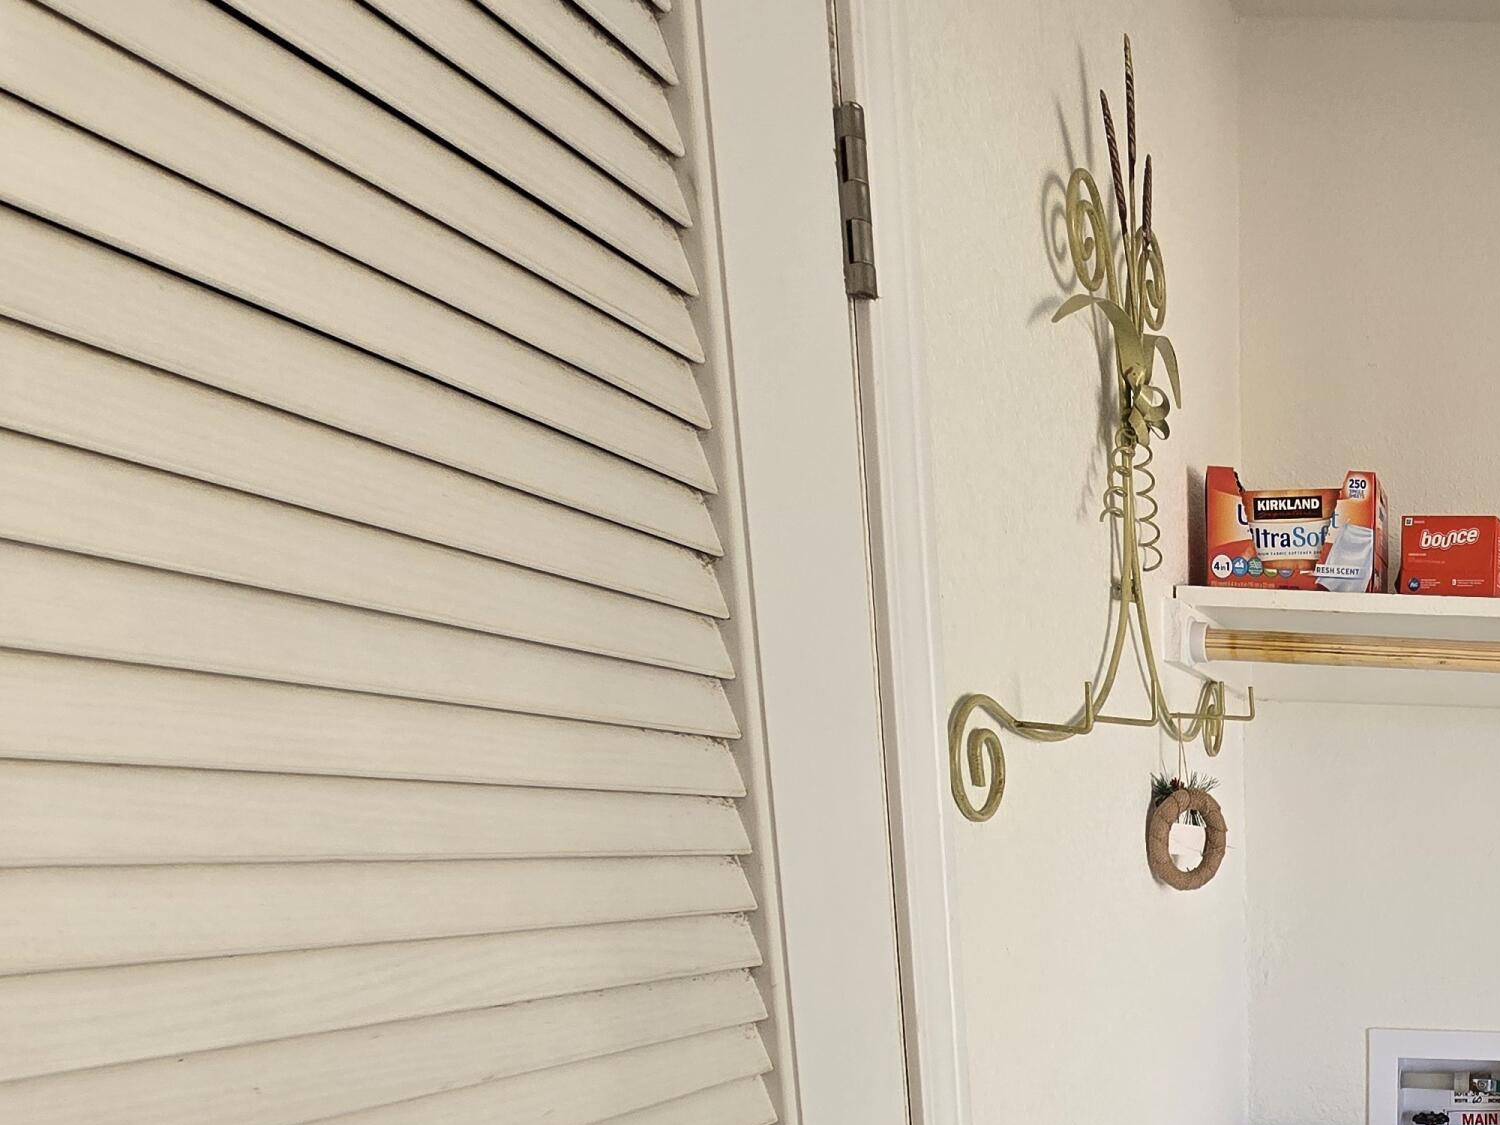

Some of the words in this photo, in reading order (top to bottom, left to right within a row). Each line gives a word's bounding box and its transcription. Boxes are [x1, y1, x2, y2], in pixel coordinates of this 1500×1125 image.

[1348, 478, 1367, 490] 250
[1257, 498, 1320, 511] KIRKLAND
[1249, 525, 1329, 549] ltraSof
[1420, 528, 1480, 549] bounce
[1316, 566, 1335, 574] RESH
[1336, 567, 1360, 576] SCENT
[1462, 1113, 1498, 1125] MAIN
